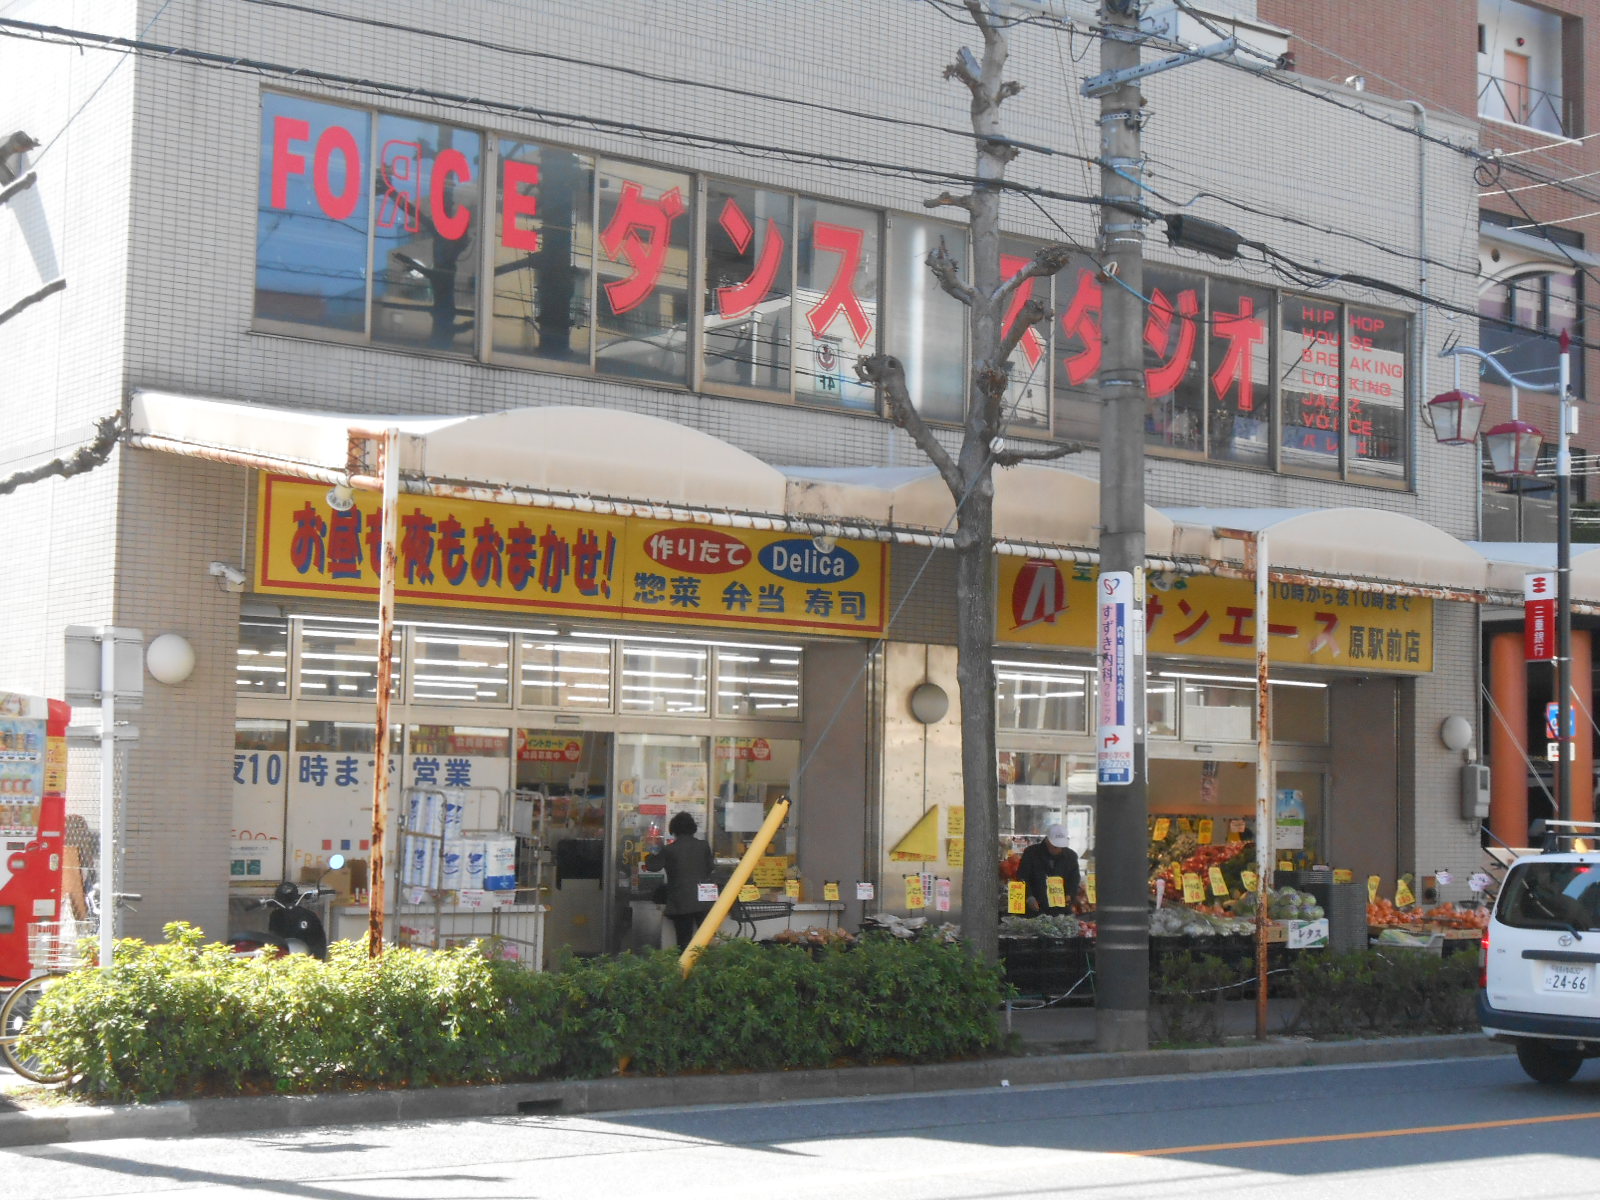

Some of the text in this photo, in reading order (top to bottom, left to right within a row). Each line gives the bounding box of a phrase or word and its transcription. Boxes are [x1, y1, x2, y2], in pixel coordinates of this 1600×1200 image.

[1302, 306, 1385, 333] HIP HOP
[650, 534, 745, 566] 作りたて
[772, 546, 845, 577] Delica
[633, 572, 866, 621] 惣菜 弁当 寿司
[1254, 582, 1412, 612] 10時から夜10時まで
[1350, 624, 1421, 663] 原駅前店
[1299, 929, 1321, 939] レタス
[1553, 974, 1587, 990] 24-66
